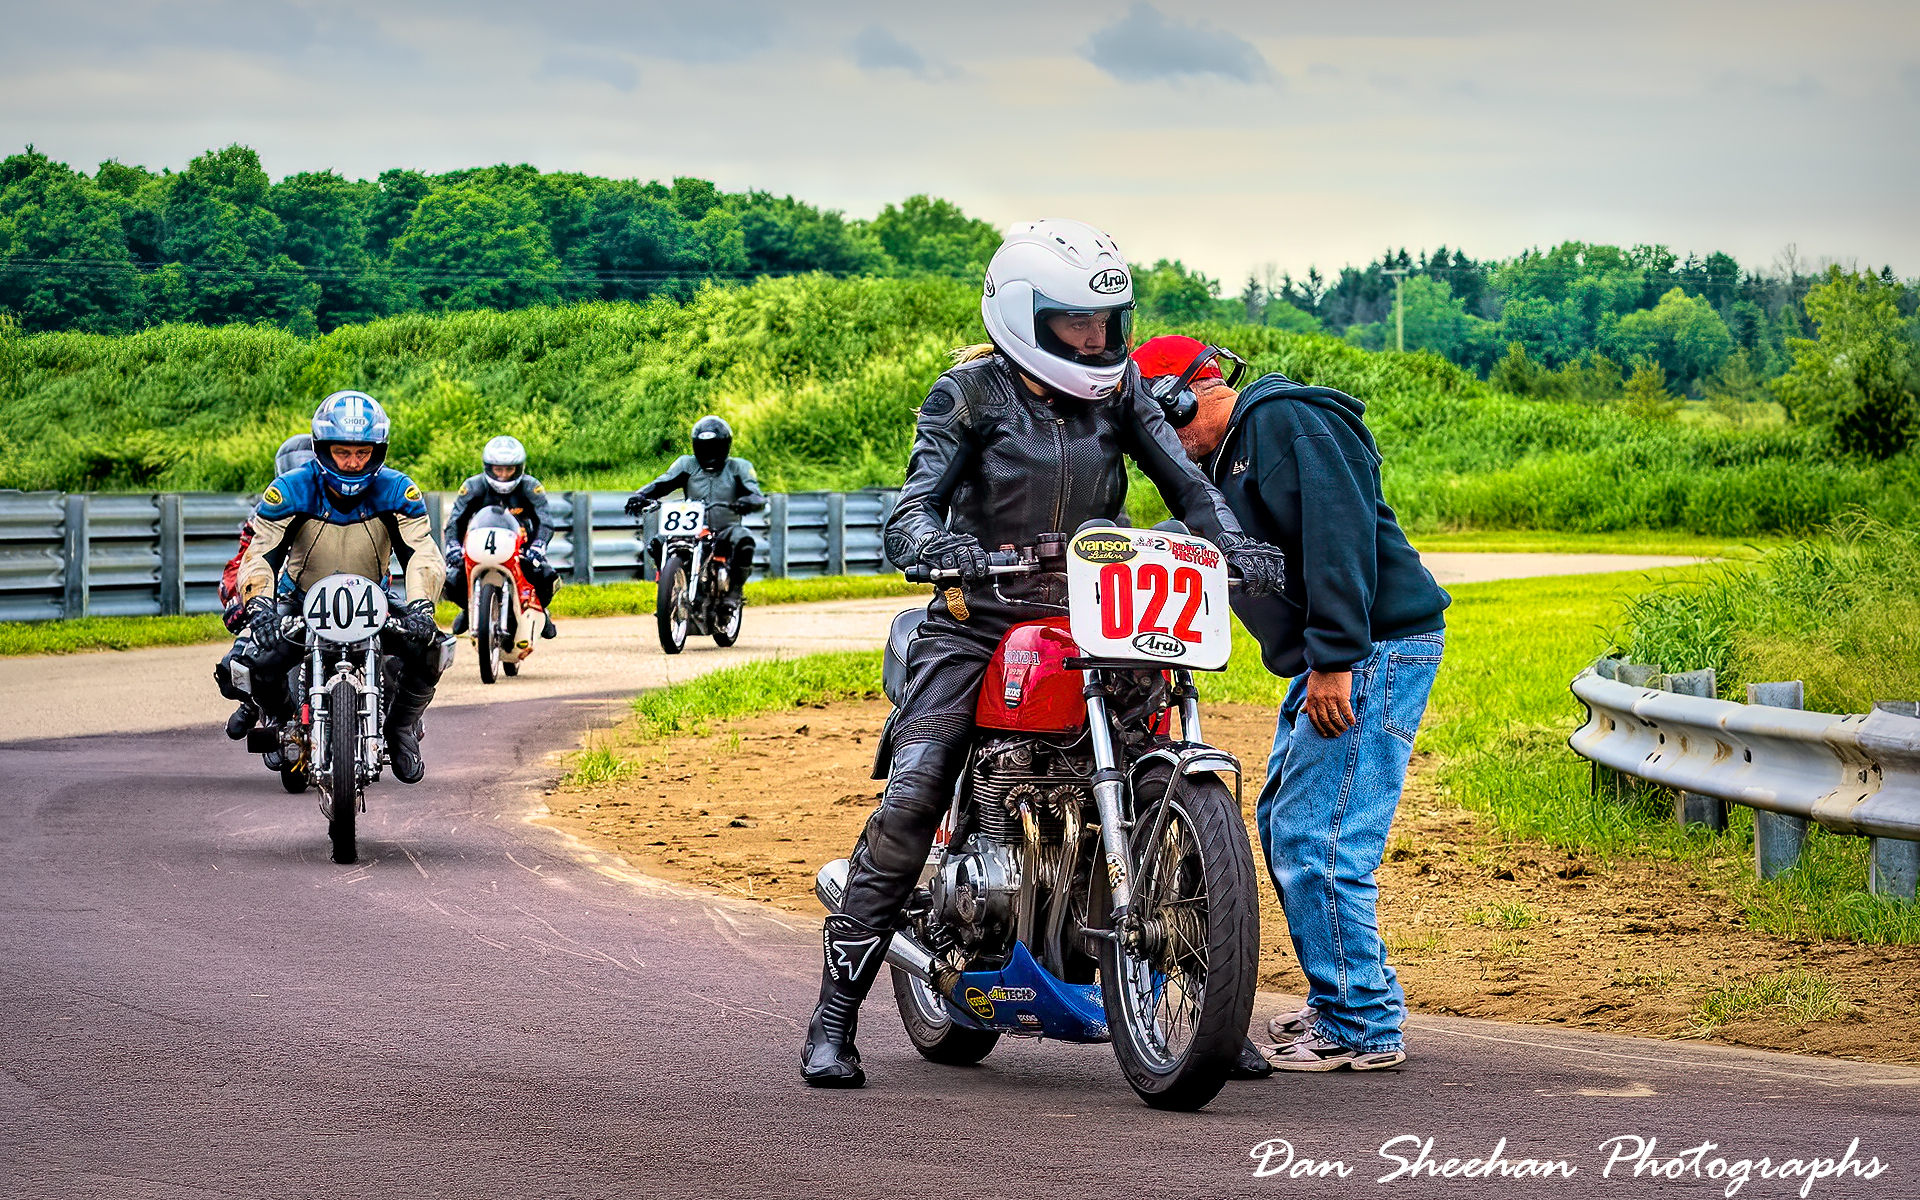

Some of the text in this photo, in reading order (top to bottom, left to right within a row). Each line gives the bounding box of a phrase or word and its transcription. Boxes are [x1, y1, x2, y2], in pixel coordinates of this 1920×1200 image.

[1095, 272, 1125, 289] Arai
[664, 510, 699, 531] 83
[485, 530, 497, 554] 4
[1077, 540, 1133, 553] vanson
[1154, 539, 1166, 551] 2
[1174, 550, 1219, 569] HISTORY
[308, 585, 379, 630] 404
[1099, 563, 1203, 644] 022
[1137, 635, 1180, 652] Arai
